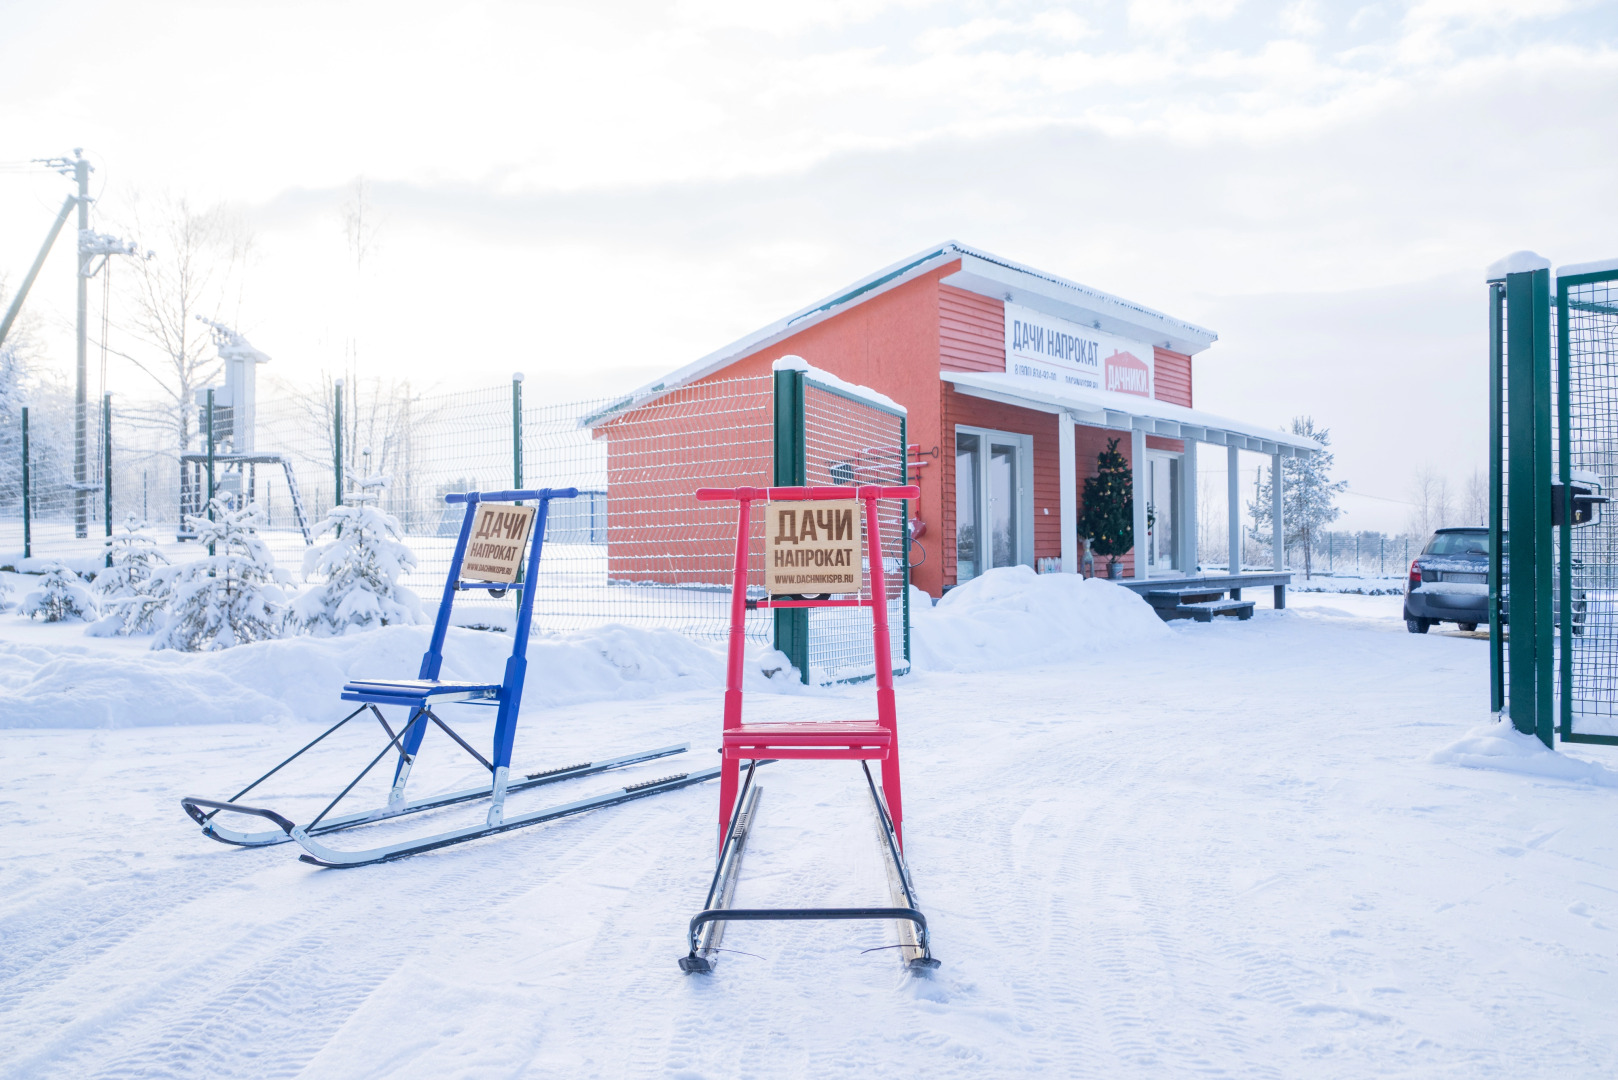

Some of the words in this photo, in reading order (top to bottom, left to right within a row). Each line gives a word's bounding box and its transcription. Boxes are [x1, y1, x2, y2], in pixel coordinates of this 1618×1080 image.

[1012, 319, 1044, 354] ДАЧИ
[1047, 329, 1099, 367] НАПРОКАТ
[475, 510, 527, 540] ДАЧИ
[774, 508, 853, 545] ДАЧИ
[470, 542, 518, 562] НАПРОКАТ
[774, 548, 853, 568] НАПРОКАТ
[466, 562, 513, 575] WWW.DACHNIKISPB.RU
[774, 574, 854, 584] WWW.DACHNIKISPB.RU
